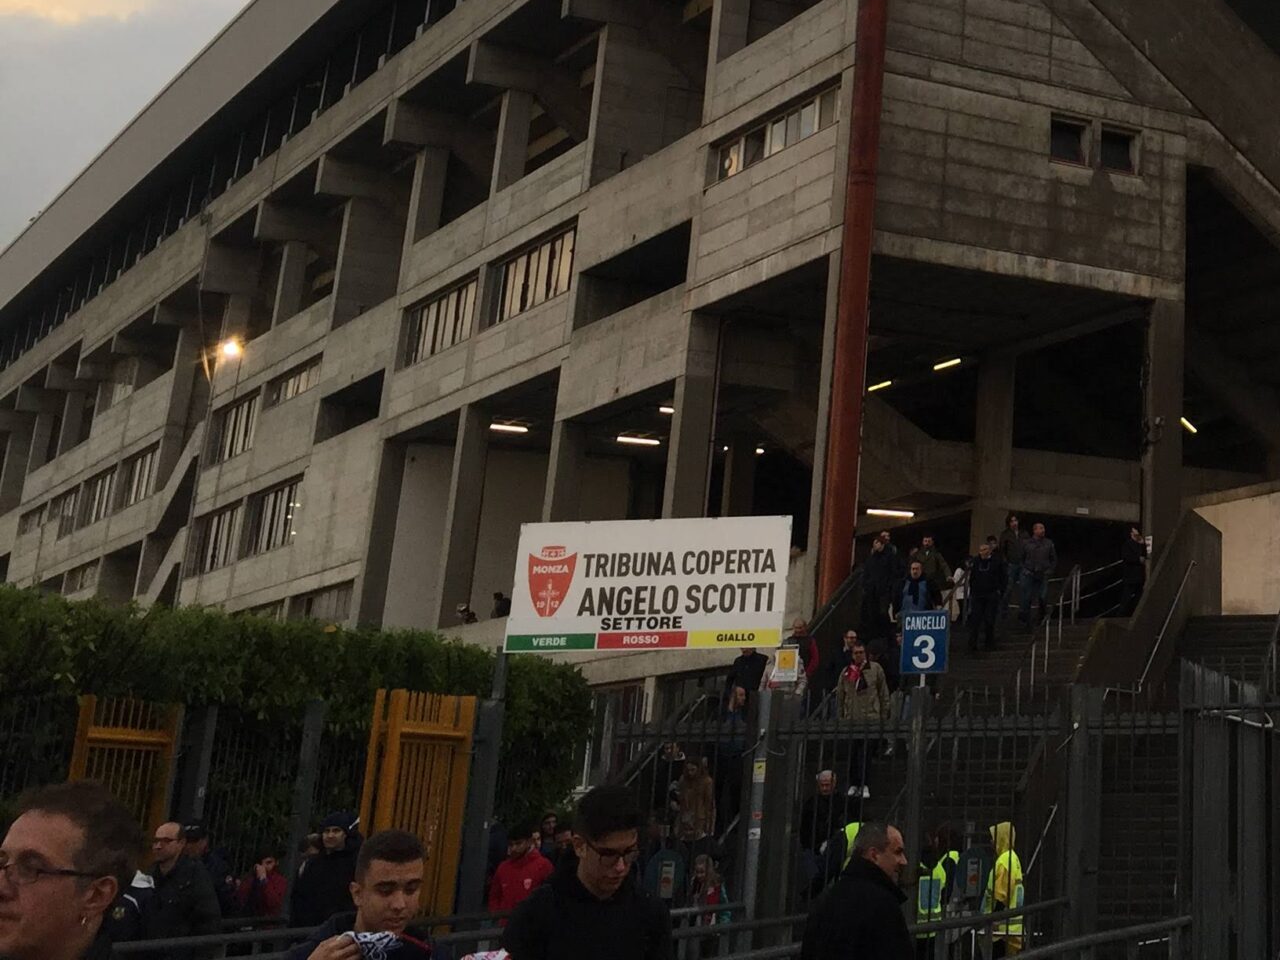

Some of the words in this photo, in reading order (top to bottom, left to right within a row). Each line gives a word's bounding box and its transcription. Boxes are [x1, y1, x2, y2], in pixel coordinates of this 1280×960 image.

[533, 565, 569, 574] MONZA
[583, 551, 676, 578] TRIBUNA
[682, 549, 776, 576] COPERTA
[536, 600, 546, 609] 19
[550, 600, 560, 608] 12
[576, 585, 680, 617] ANGELO
[685, 582, 775, 614] SCOTTI
[600, 616, 683, 631] SETTORE
[905, 616, 946, 631] CANCELLO
[532, 637, 567, 647] VERDE
[623, 635, 660, 645] ROSSO
[716, 633, 755, 642] GIALLO
[911, 635, 936, 669] 3
